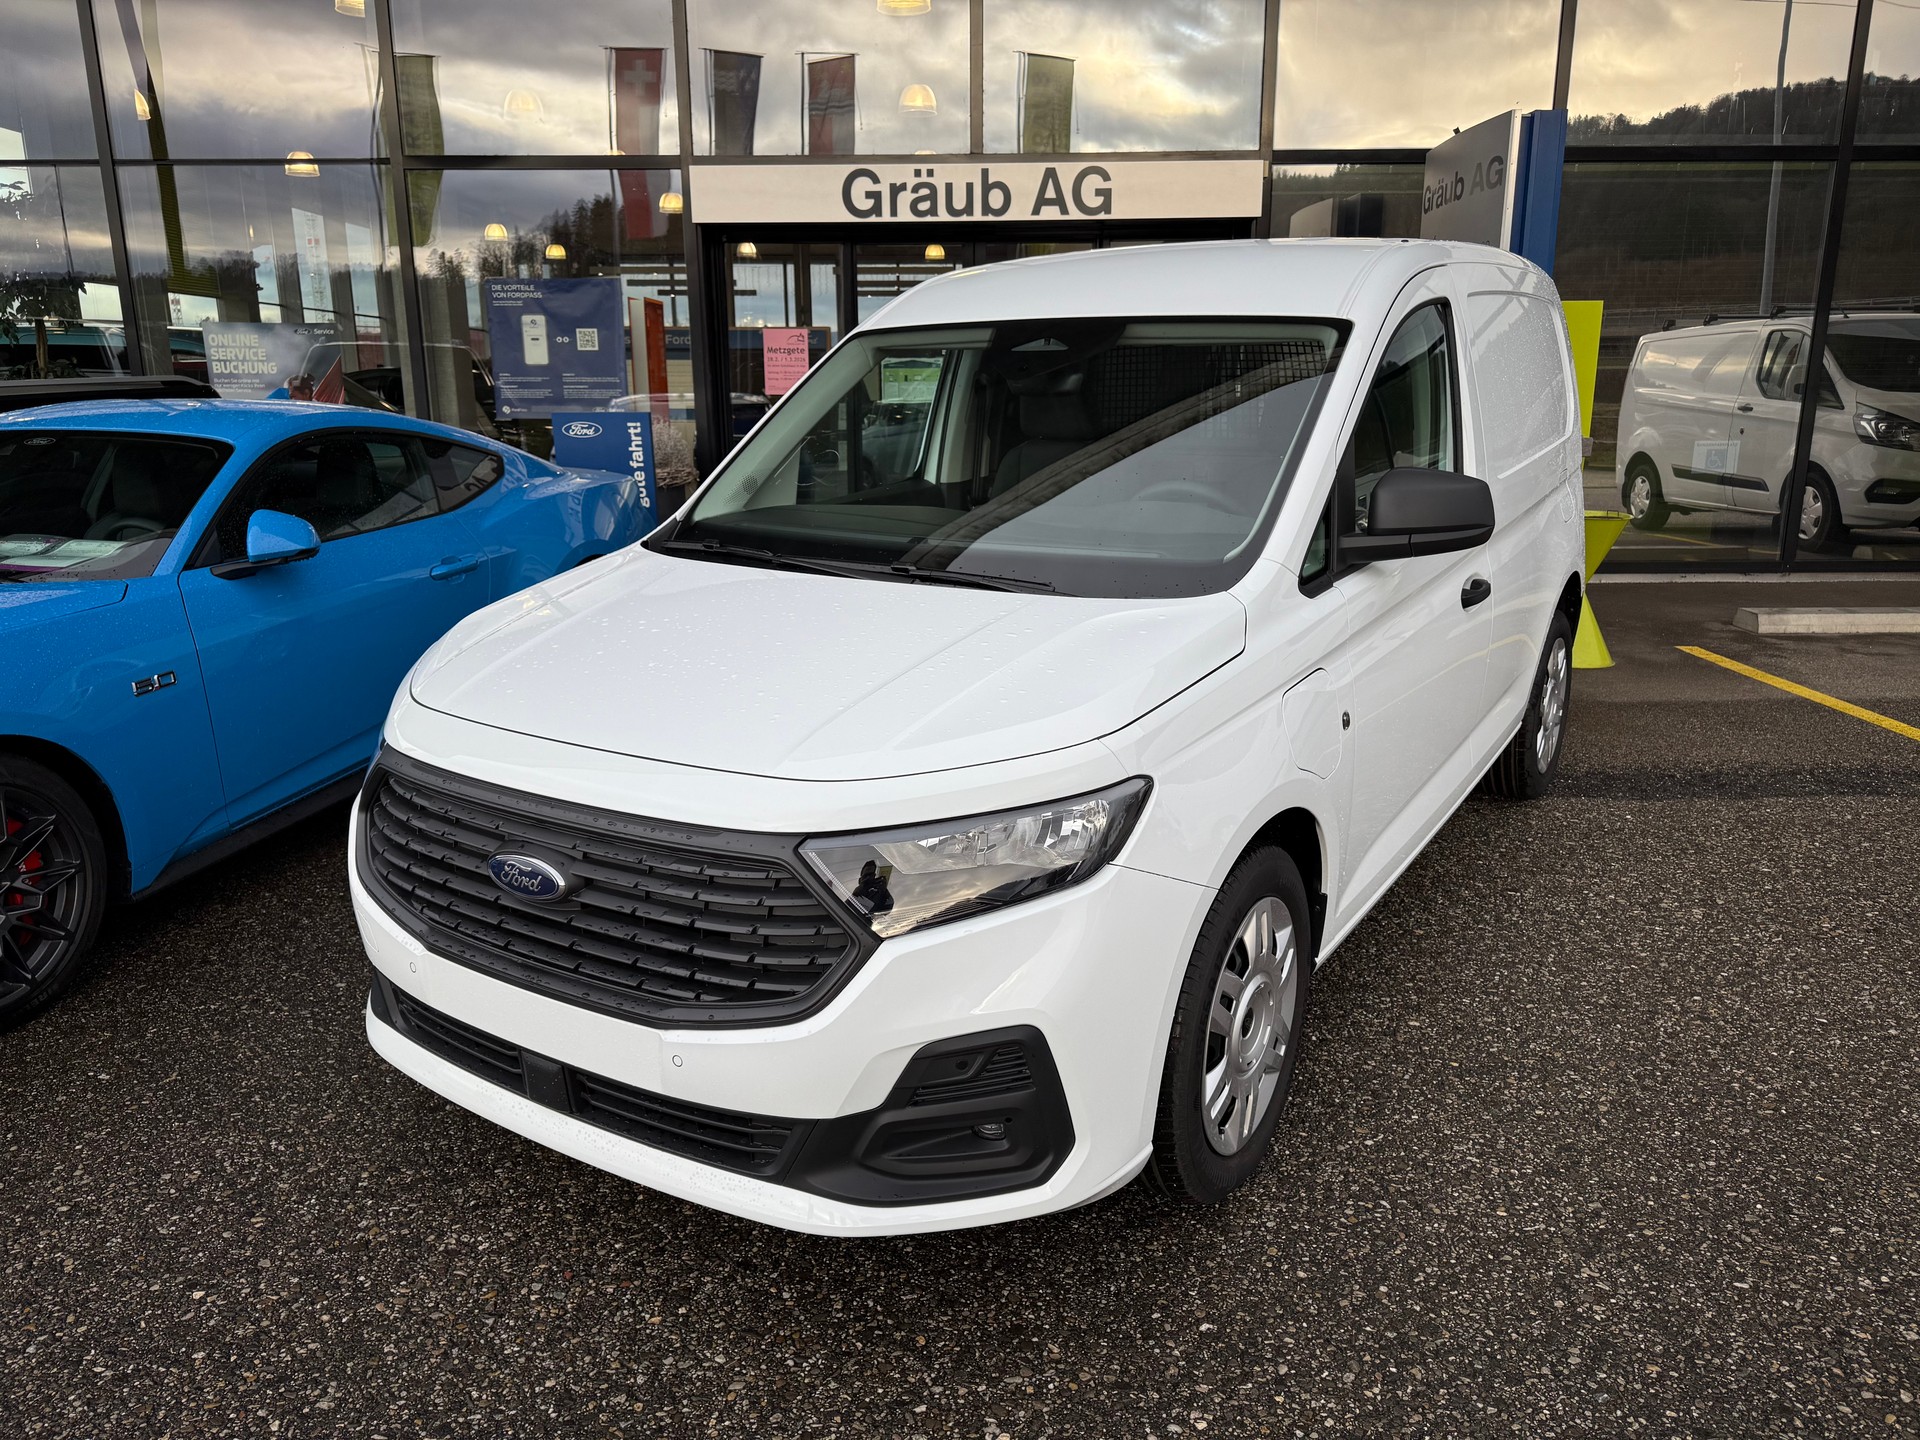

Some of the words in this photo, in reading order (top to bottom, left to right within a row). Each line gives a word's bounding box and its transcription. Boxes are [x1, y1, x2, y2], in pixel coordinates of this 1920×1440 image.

[842, 167, 1012, 219] Gräub
[1031, 165, 1113, 217] AG
[1423, 170, 1465, 215] Gräub
[1469, 155, 1504, 196] AG
[208, 334, 259, 346] ONLINE
[767, 346, 806, 356] Metzgete
[210, 348, 267, 360] SERVICE
[212, 361, 278, 374] BUCHUNG
[626, 422, 645, 468] fahrt!
[500, 860, 542, 892] Ford
